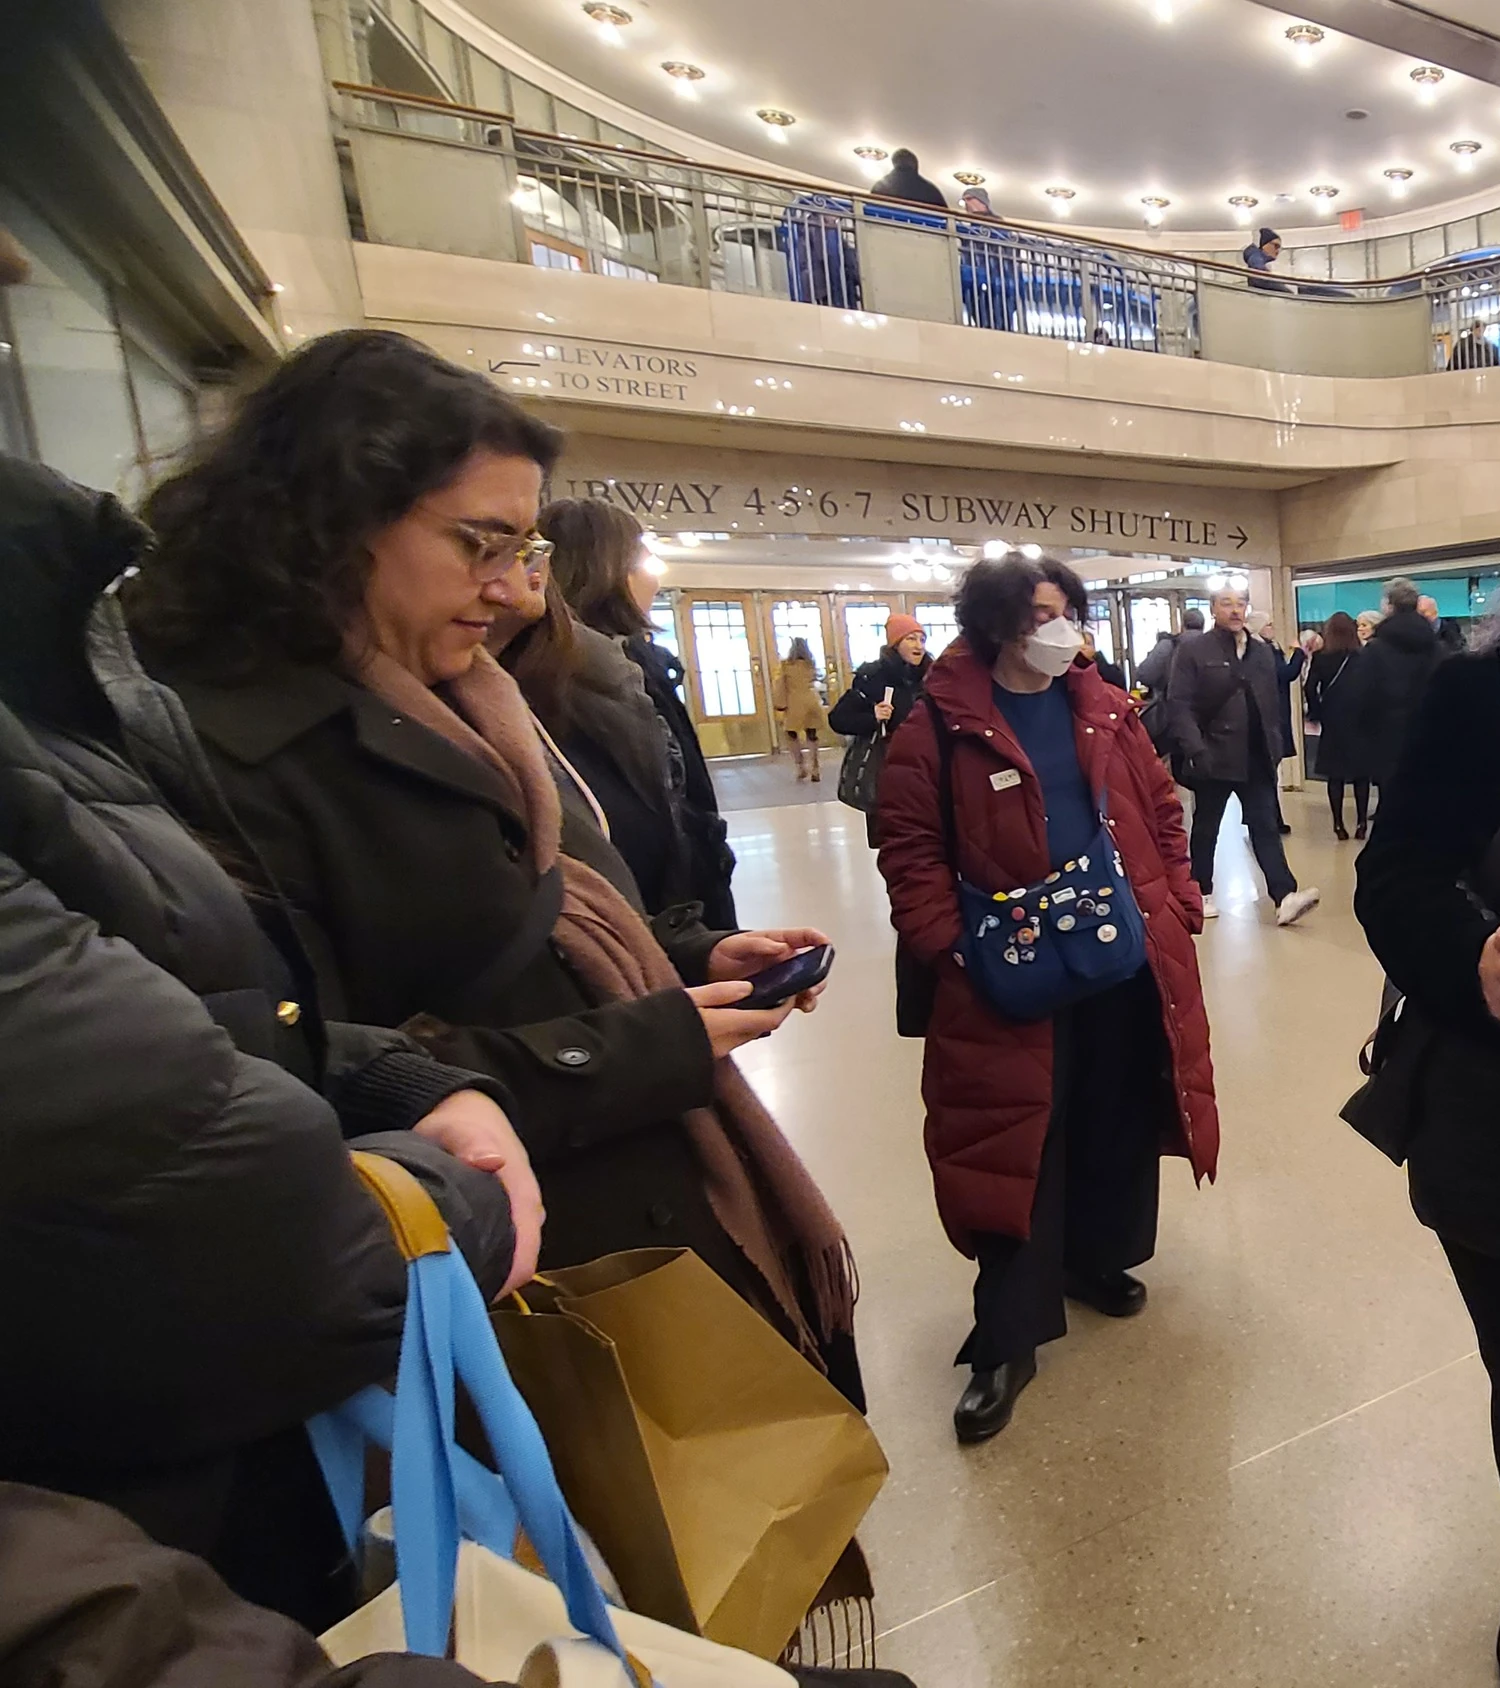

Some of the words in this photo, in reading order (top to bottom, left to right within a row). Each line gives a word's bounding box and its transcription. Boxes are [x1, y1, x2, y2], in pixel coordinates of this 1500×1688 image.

[542, 343, 698, 378] ELEVATORS
[555, 371, 590, 390] TO
[596, 376, 688, 401] STREET
[541, 478, 723, 514] UBWAY
[901, 492, 1059, 530] SUBWAY
[1070, 506, 1218, 546] SHUTTLE
